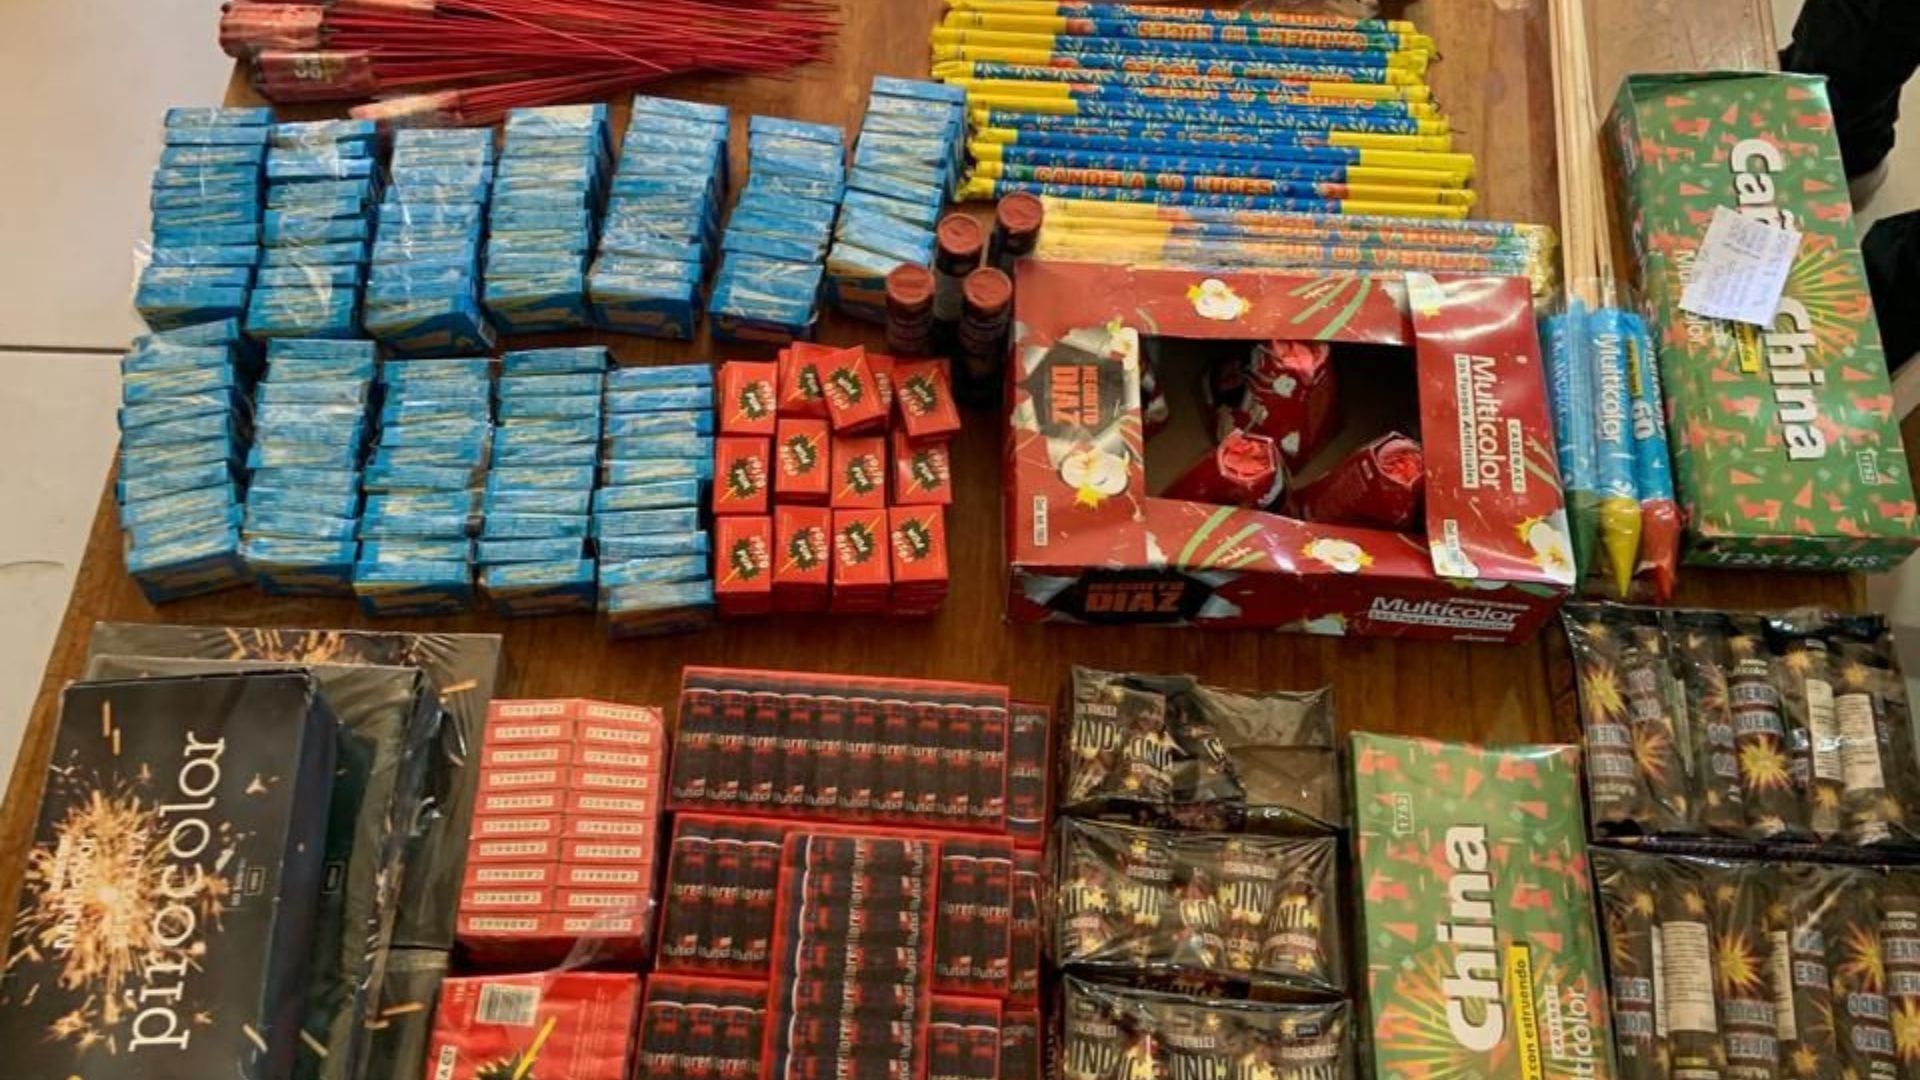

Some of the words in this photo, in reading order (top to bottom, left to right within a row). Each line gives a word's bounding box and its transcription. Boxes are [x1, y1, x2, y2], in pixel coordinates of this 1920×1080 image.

[1137, 20, 1213, 39] LUCES
[1222, 25, 1248, 42] 10
[1257, 27, 1367, 49] CANDELA
[1034, 167, 1145, 188] CANDELA
[1157, 174, 1185, 190] 10
[1194, 175, 1274, 195] LUCES
[1051, 366, 1081, 427] DIAZ
[1596, 333, 1627, 443] Multicolor
[1764, 297, 1825, 460] China
[1472, 355, 1506, 490] Multicolor
[1633, 401, 1654, 438] 60
[1461, 420, 1476, 484] Artificiales
[1087, 591, 1182, 612] DIAZ
[1371, 597, 1521, 622] Multicolor
[129, 731, 227, 1053] pirocolor
[1437, 826, 1504, 1052] China
[1514, 959, 1535, 1039] estruendo
[1527, 1042, 1538, 1071] con
